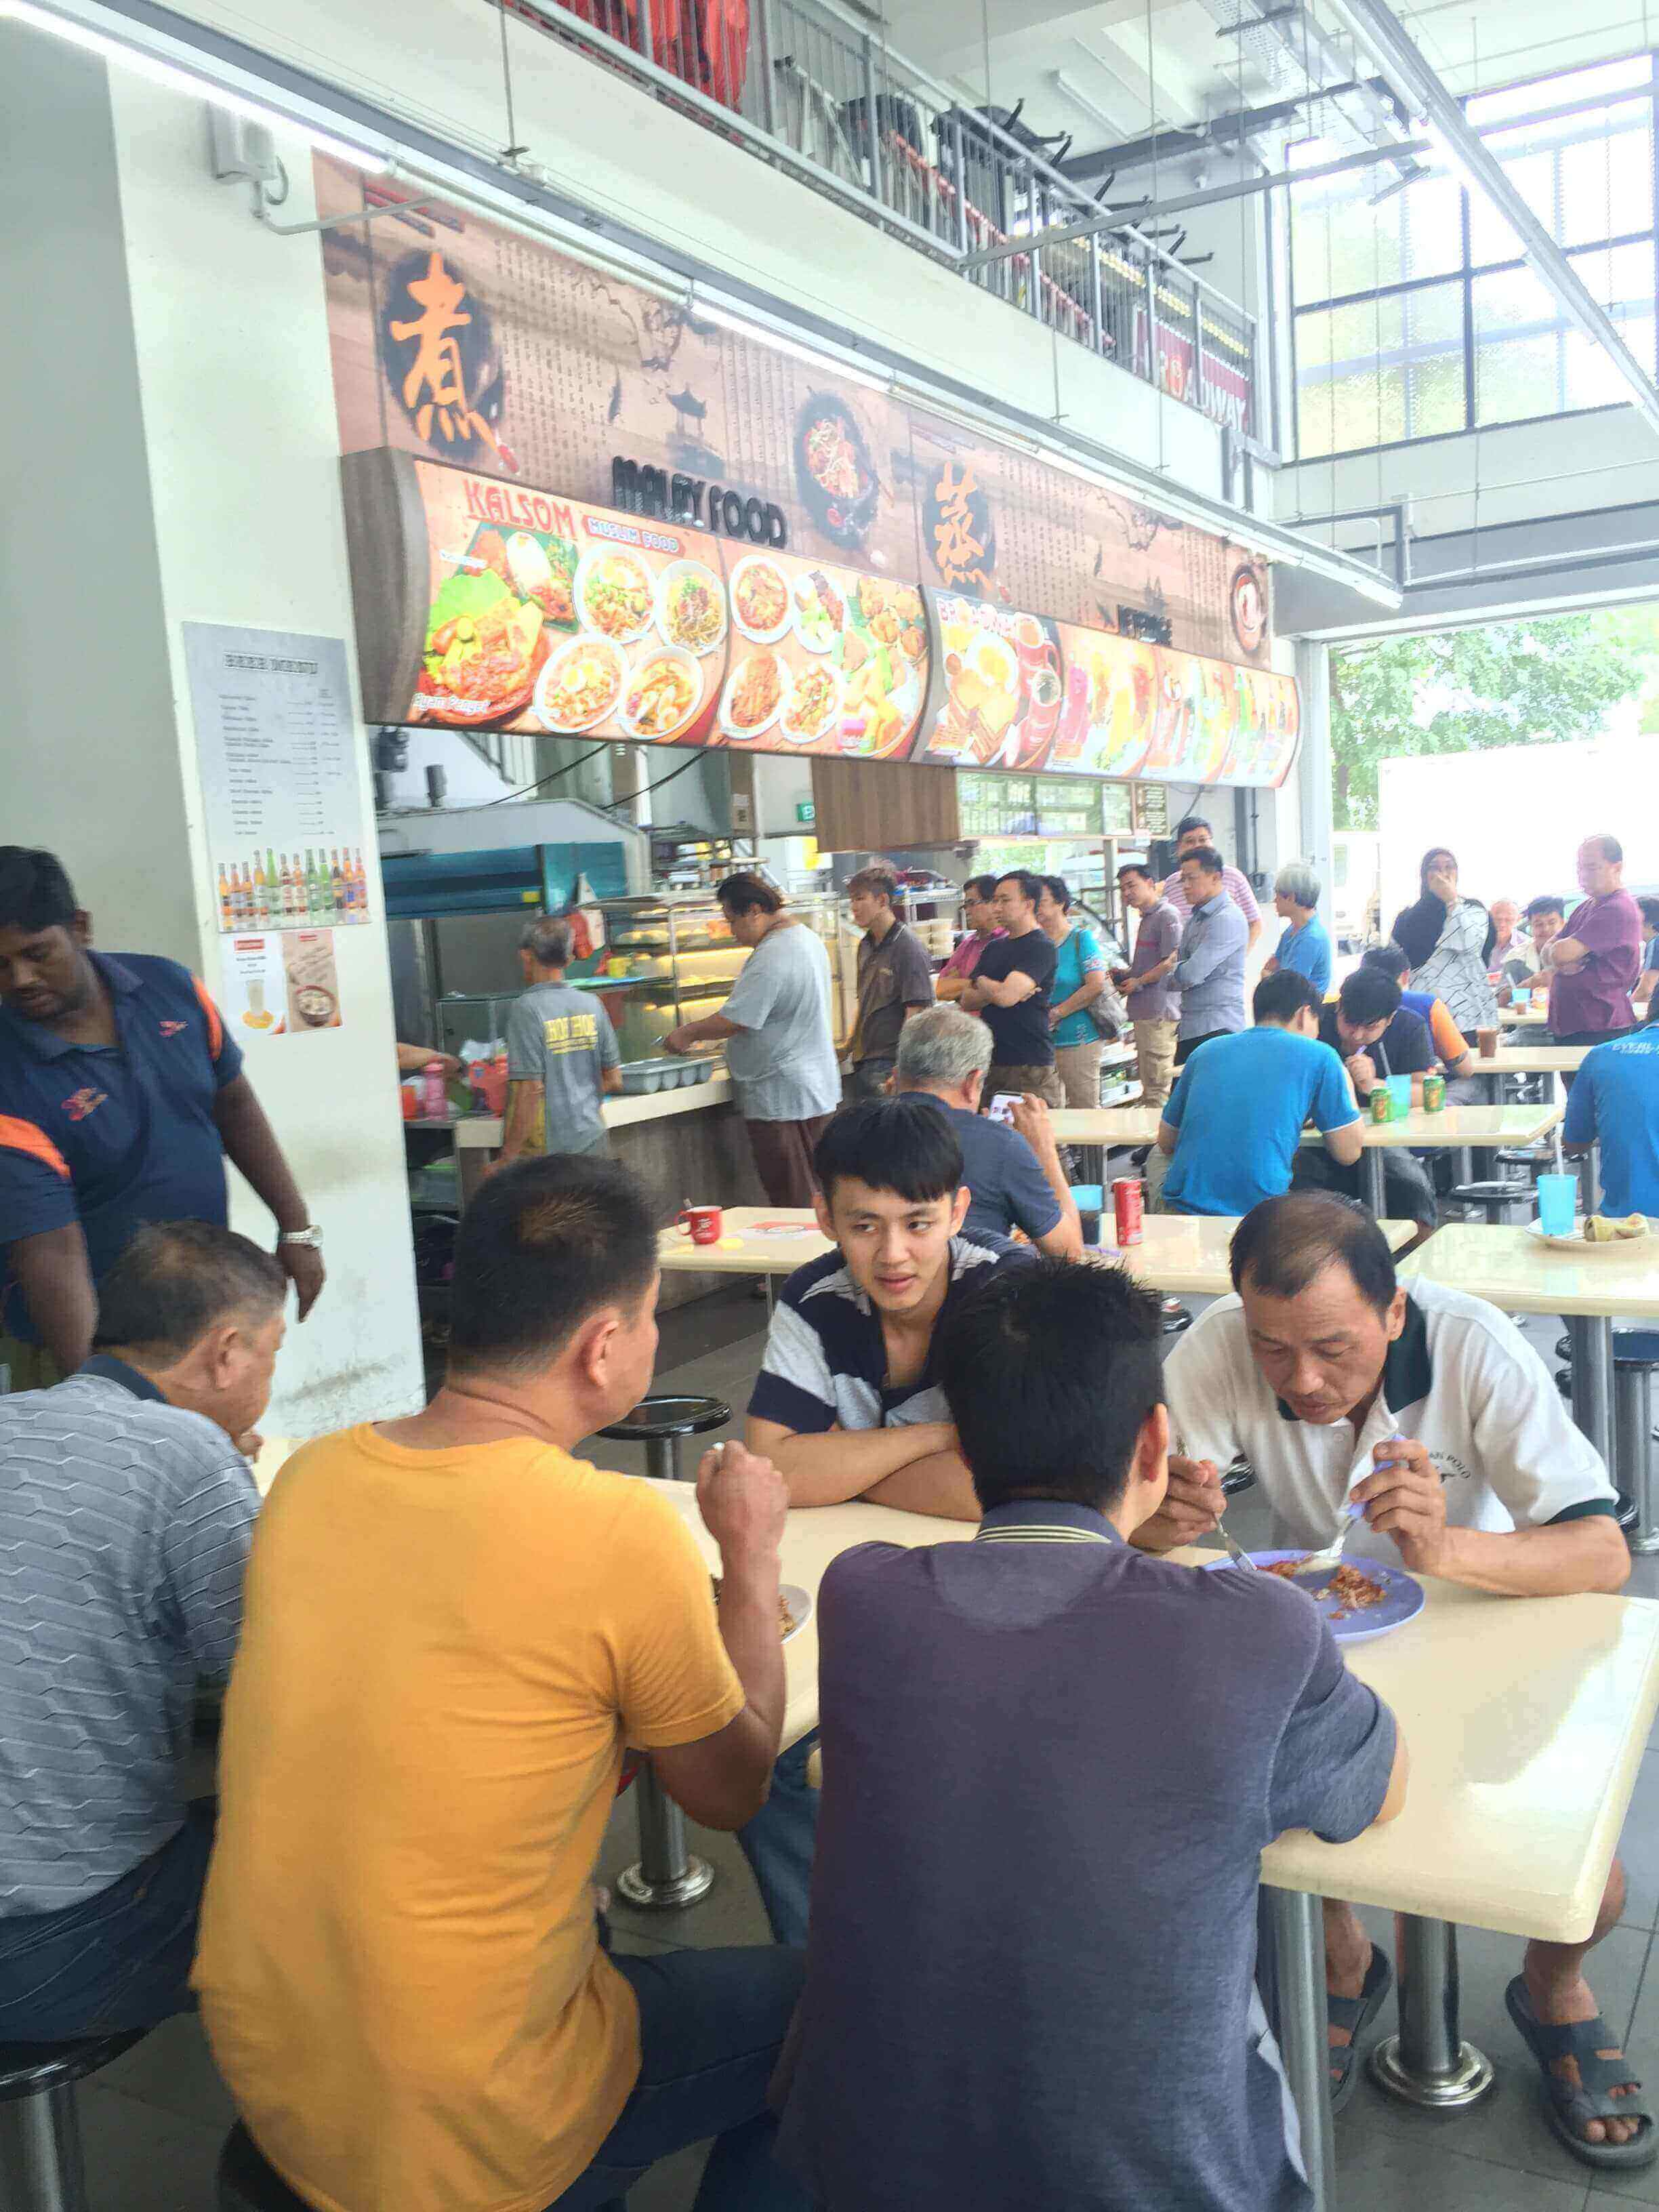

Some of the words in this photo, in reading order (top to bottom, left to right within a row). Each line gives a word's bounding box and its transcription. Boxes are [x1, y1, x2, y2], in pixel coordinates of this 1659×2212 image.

[390, 252, 498, 451] 煮
[462, 476, 578, 541] KALSOM
[588, 516, 638, 544] MUSLIM
[642, 531, 678, 552] FOOD
[709, 485, 787, 549] FOOD
